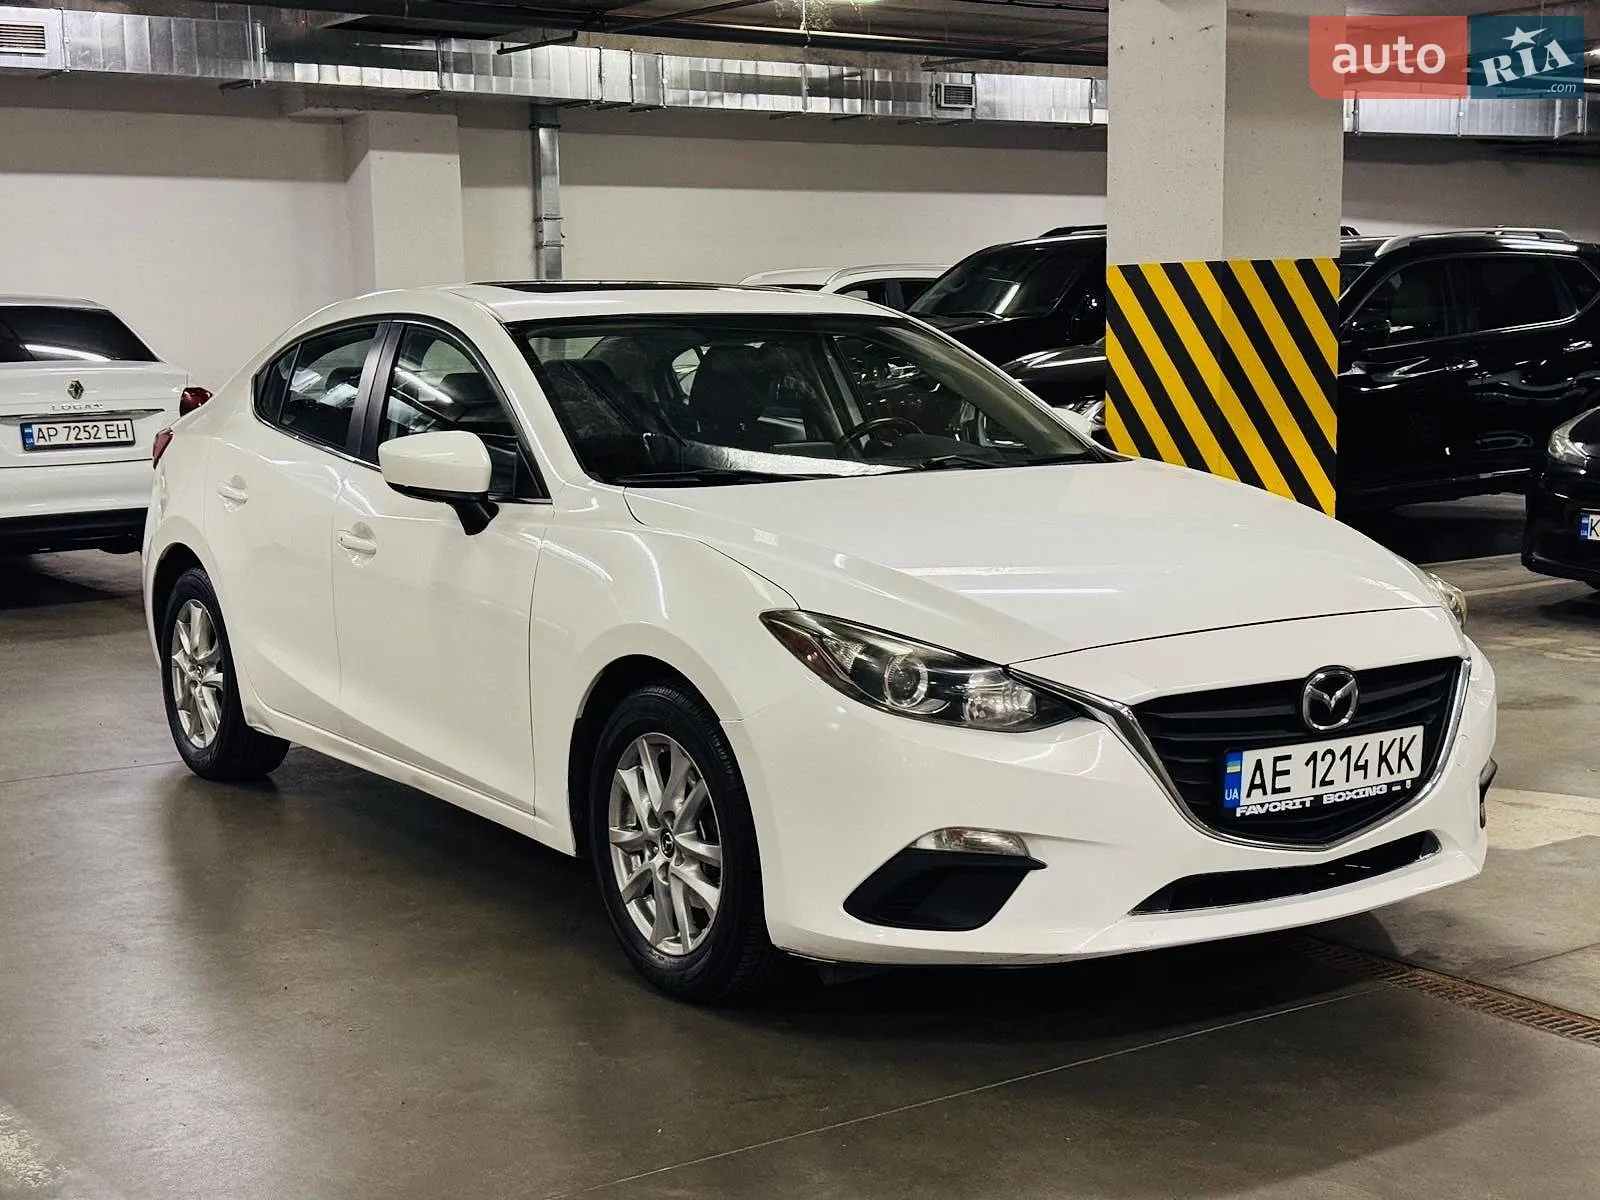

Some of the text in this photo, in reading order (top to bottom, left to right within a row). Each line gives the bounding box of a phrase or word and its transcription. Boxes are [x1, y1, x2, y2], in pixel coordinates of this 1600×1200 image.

[36, 423, 129, 443] AP 7252 EH
[1246, 734, 1417, 799] AE 1214 KK
[1224, 789, 1239, 801] UA
[1236, 784, 1388, 817] FAVORIT BOXING
